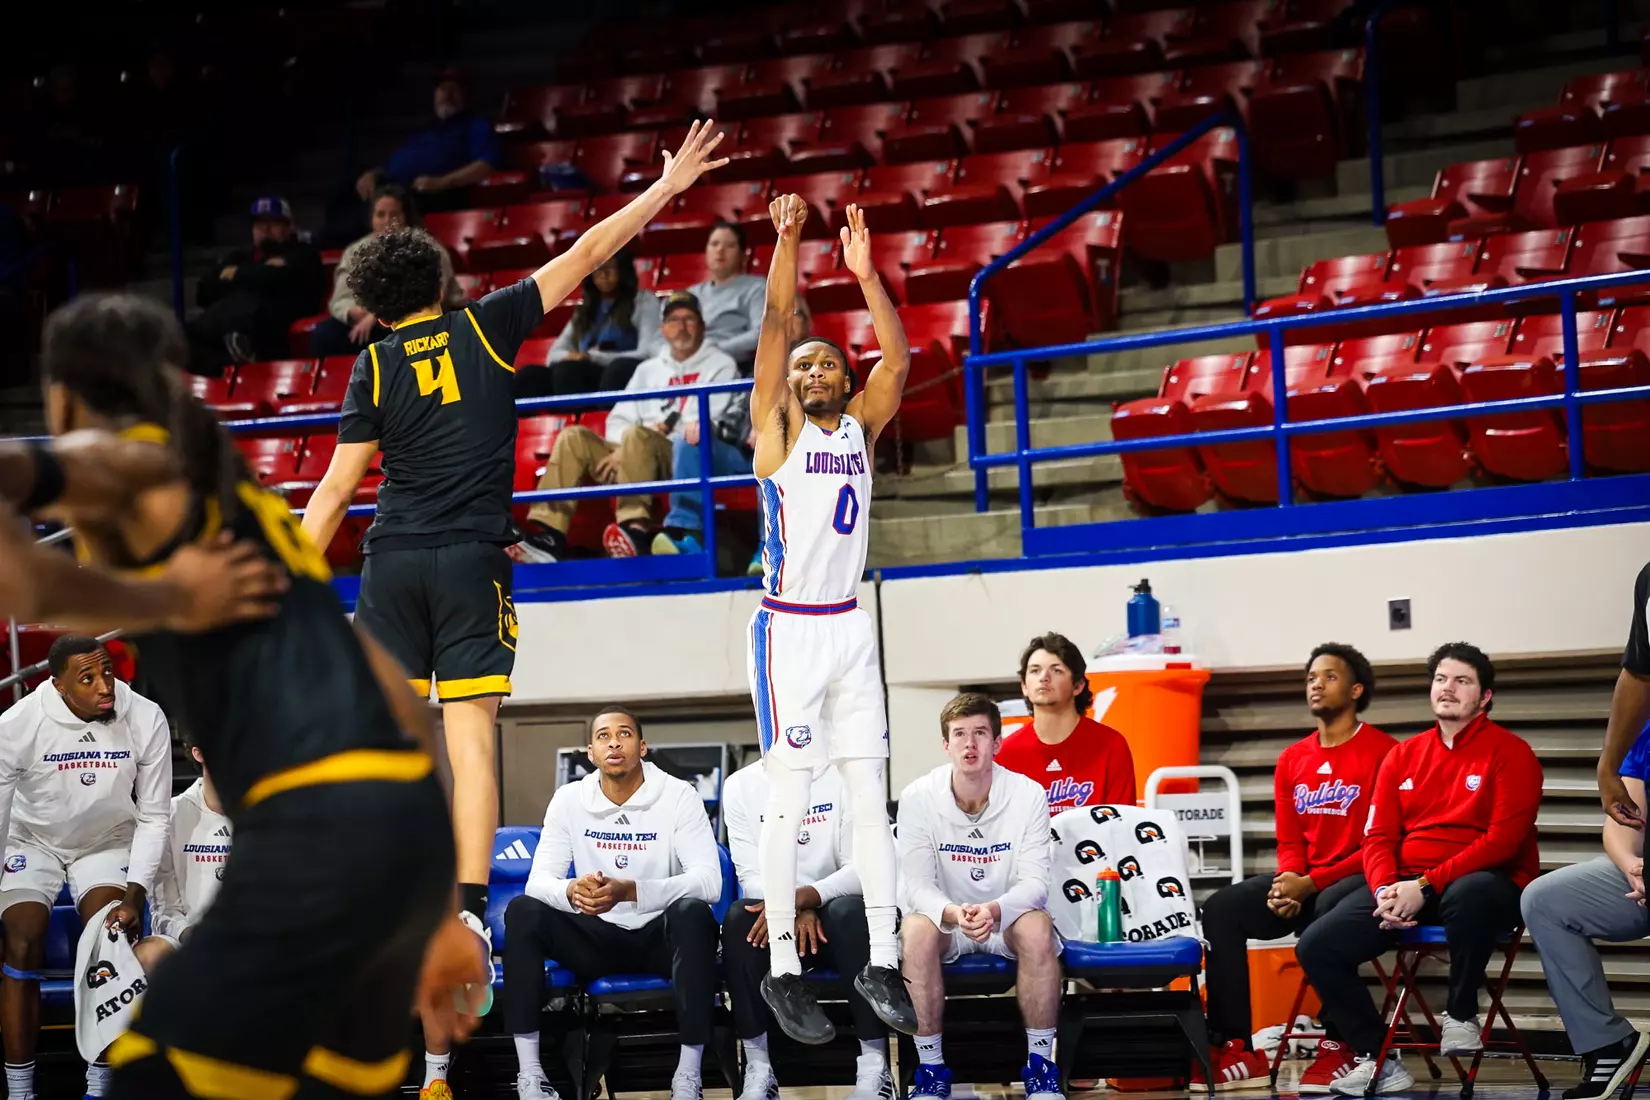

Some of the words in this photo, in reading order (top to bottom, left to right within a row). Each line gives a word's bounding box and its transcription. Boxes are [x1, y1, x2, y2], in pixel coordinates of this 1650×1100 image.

[410, 347, 461, 405] 4
[832, 483, 860, 535] 0
[43, 751, 101, 762] LOUISIANA
[104, 750, 131, 760] TECH
[58, 761, 118, 771] BASKETBALL
[1293, 779, 1361, 815] Bulldog
[584, 829, 633, 841] LOUISIANA
[635, 833, 658, 841] TECH
[597, 842, 647, 850] BASKETBALL
[939, 843, 988, 855] LOUISIANA
[990, 842, 1011, 853] TECH
[952, 854, 1001, 863] BASKETBALL
